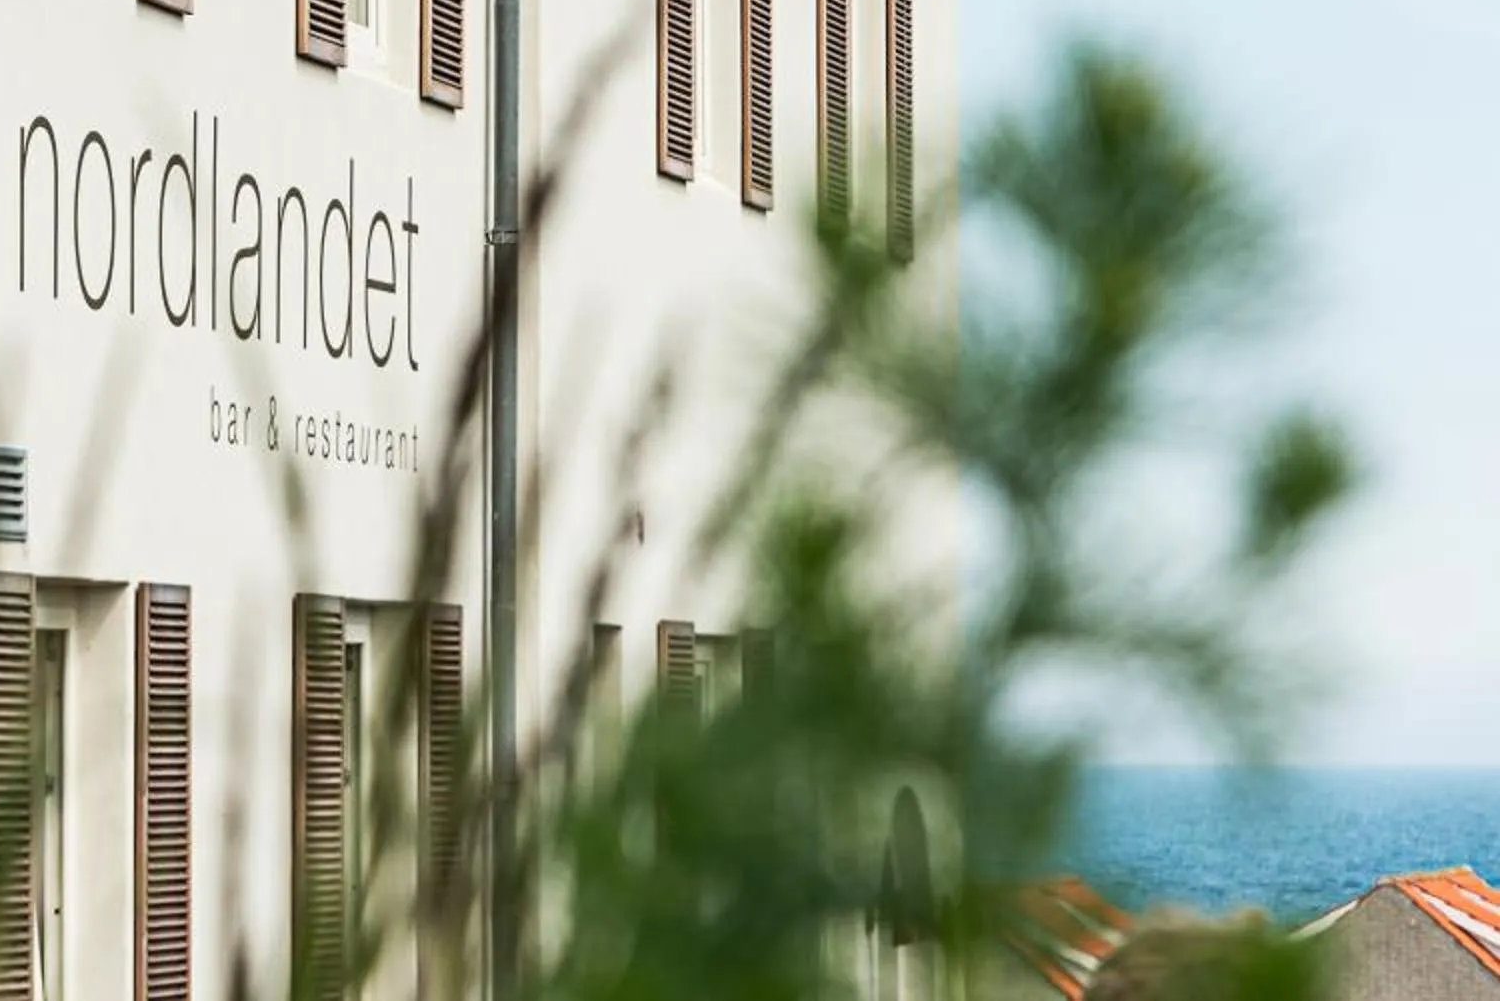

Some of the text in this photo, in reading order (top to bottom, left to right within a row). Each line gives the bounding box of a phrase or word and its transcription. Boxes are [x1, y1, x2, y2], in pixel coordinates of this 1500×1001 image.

[18, 109, 420, 372] nordlandet
[210, 385, 419, 473] bar & restaurant
